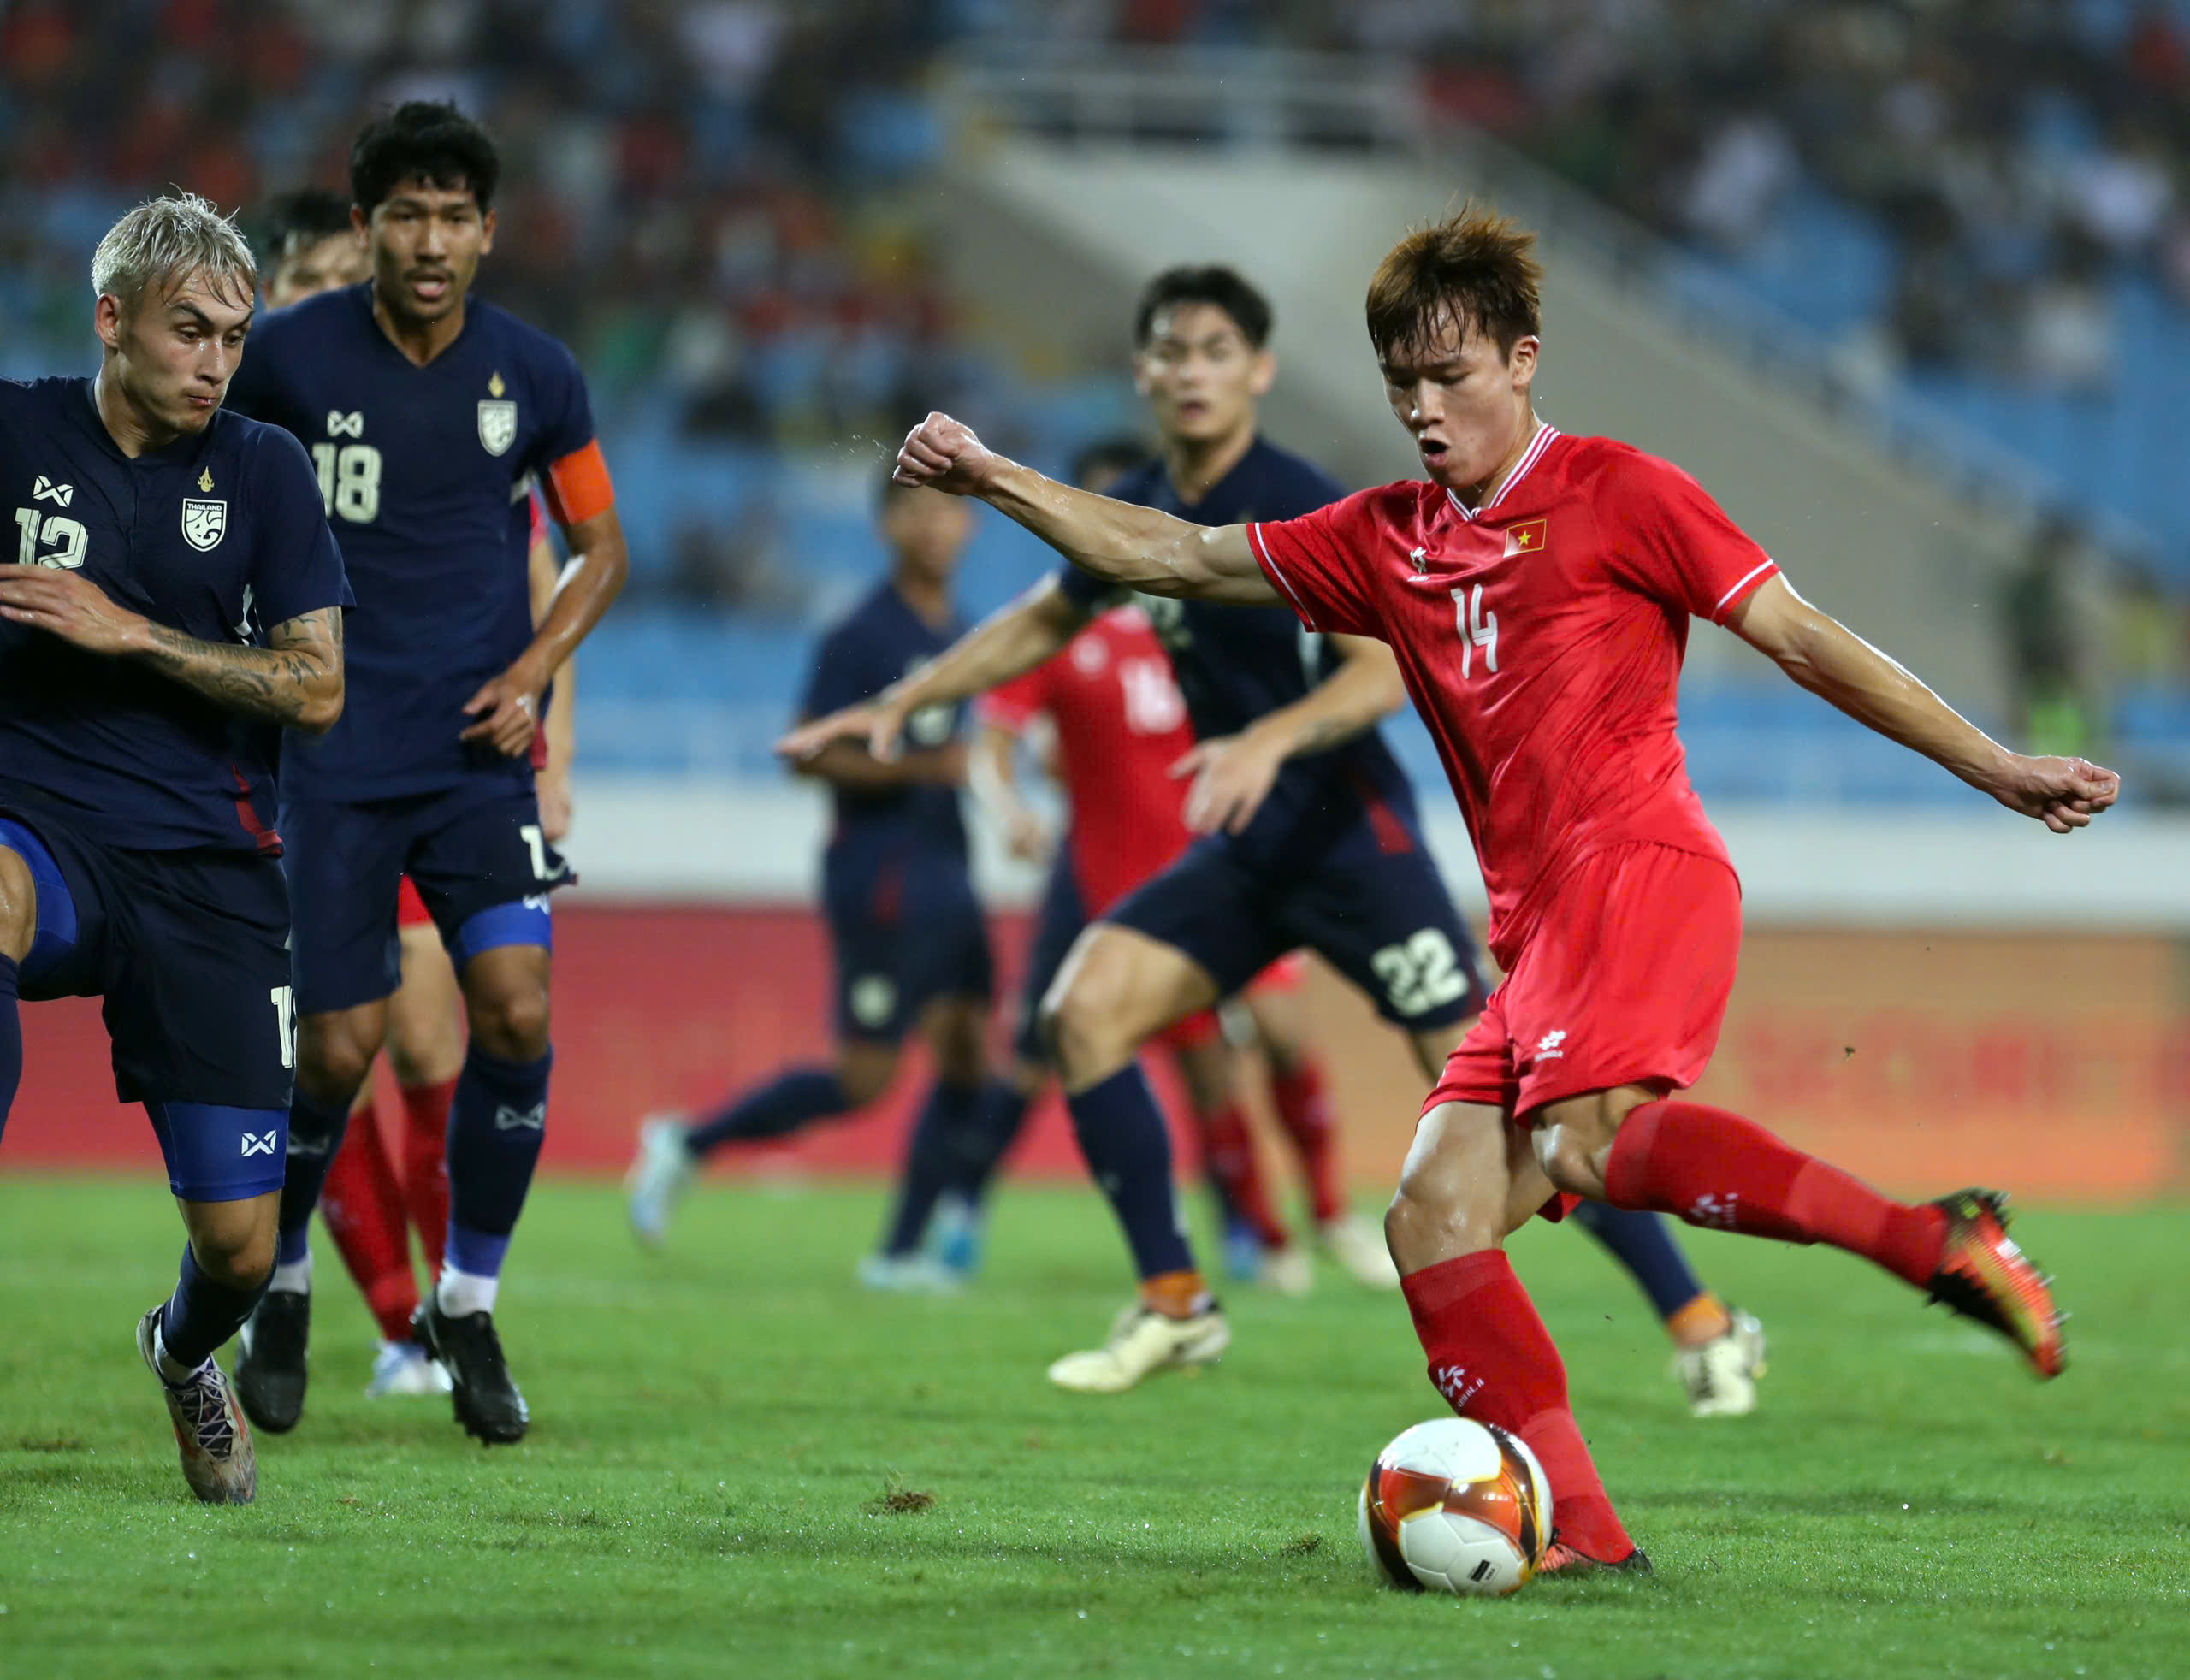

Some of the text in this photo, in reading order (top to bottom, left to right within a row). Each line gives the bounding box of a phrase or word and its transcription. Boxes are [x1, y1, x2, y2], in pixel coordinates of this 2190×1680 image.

[312, 443, 382, 524] 18
[15, 507, 89, 570] 12
[1451, 583, 1498, 679] 14
[1370, 927, 1468, 1013] 22
